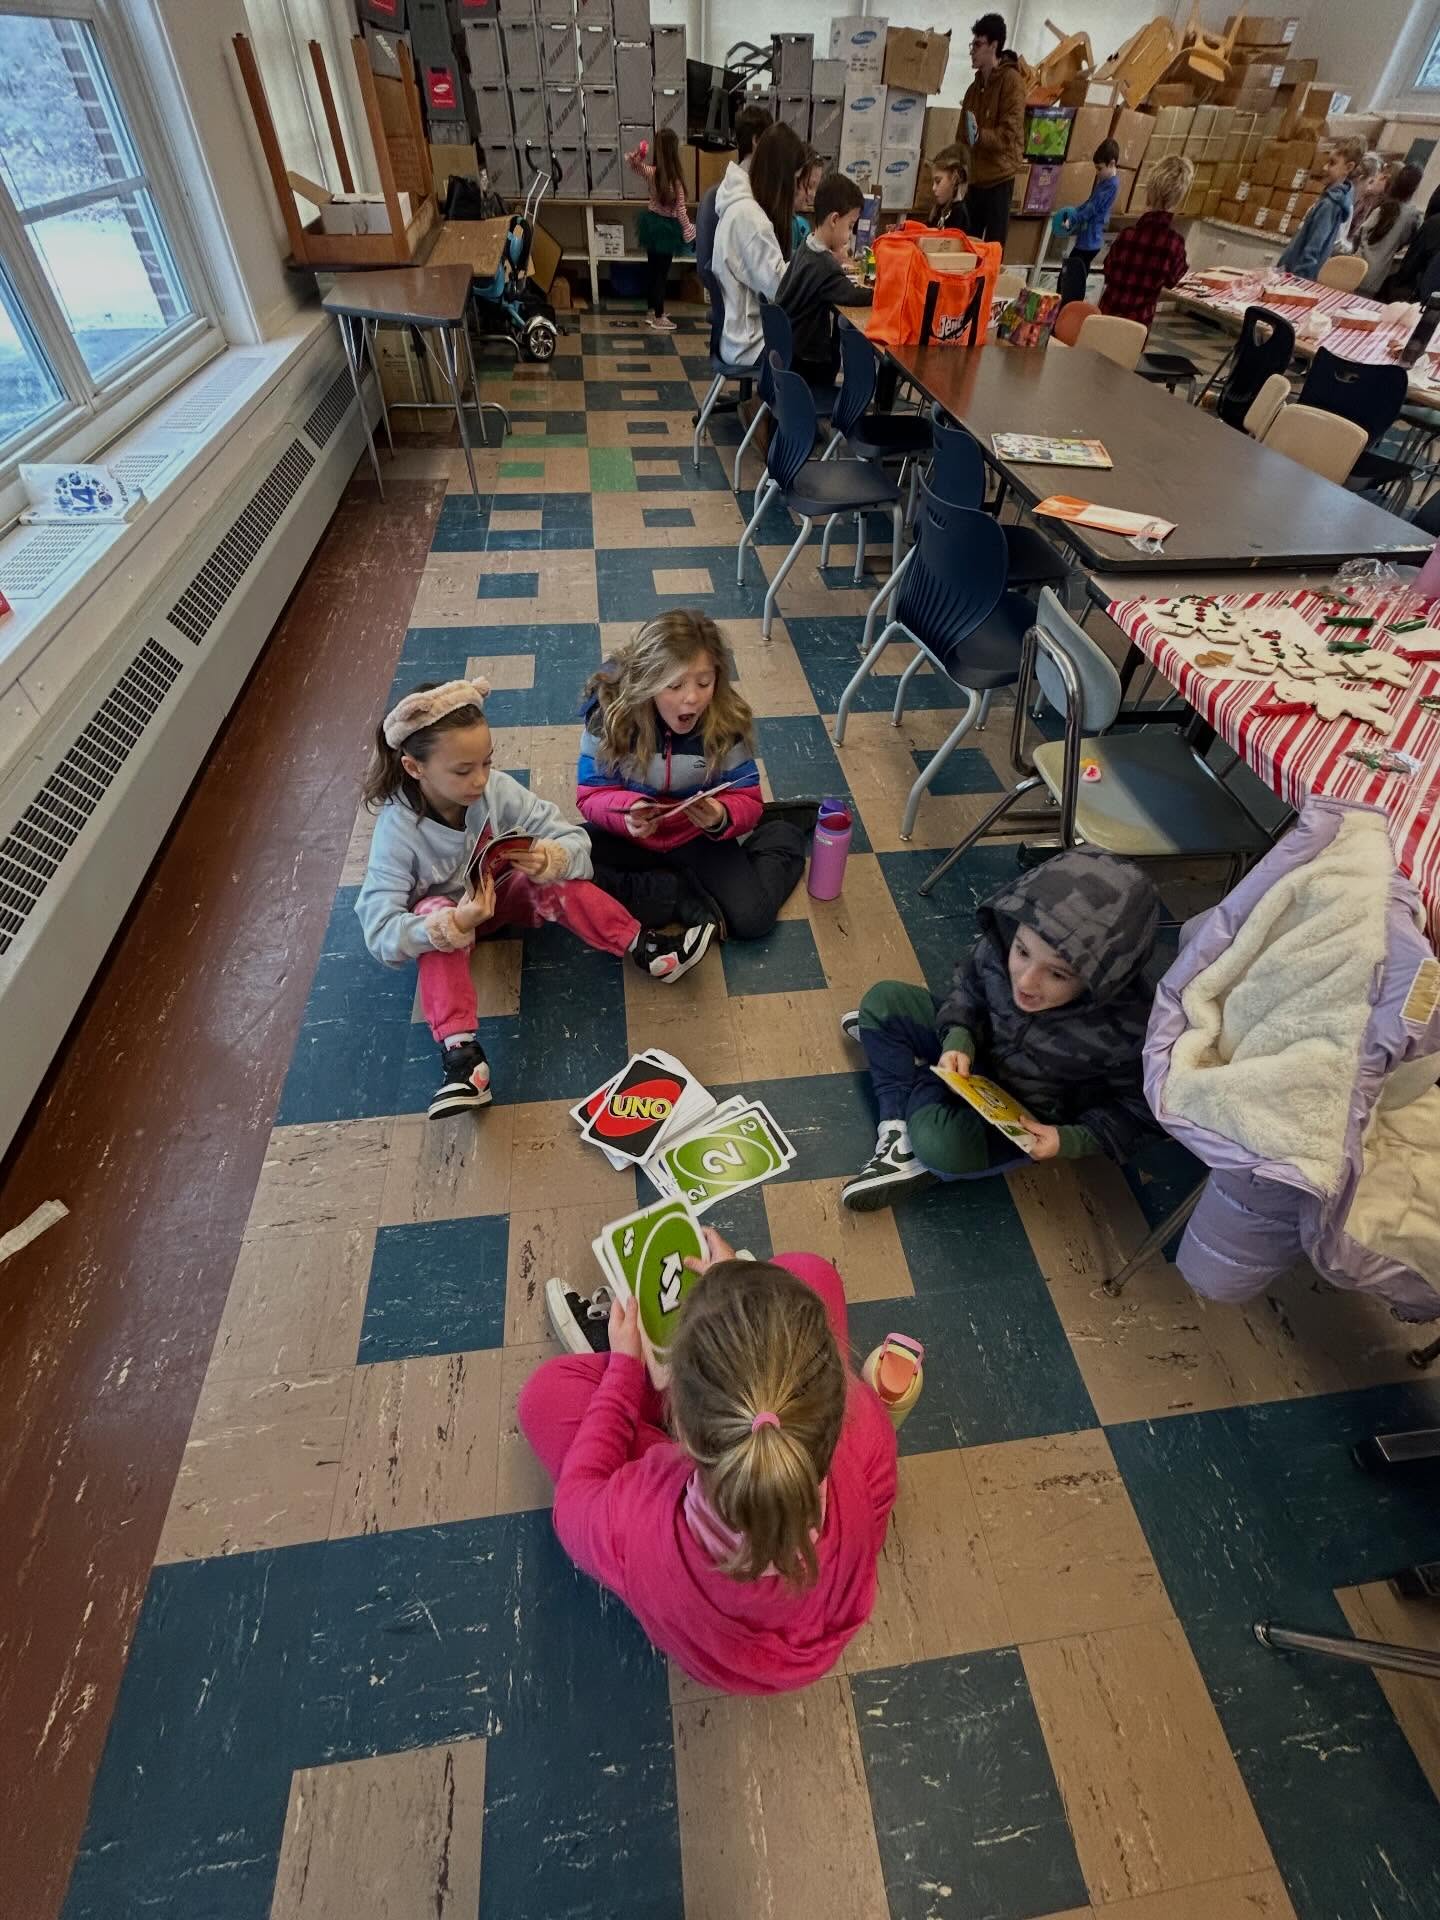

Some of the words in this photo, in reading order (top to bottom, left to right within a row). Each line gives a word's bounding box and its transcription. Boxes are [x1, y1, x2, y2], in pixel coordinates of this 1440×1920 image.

[609, 1094, 672, 1119] UNO
[739, 1120, 758, 1136] 2
[702, 1141, 745, 1174] 2
[687, 1184, 708, 1201] 2
